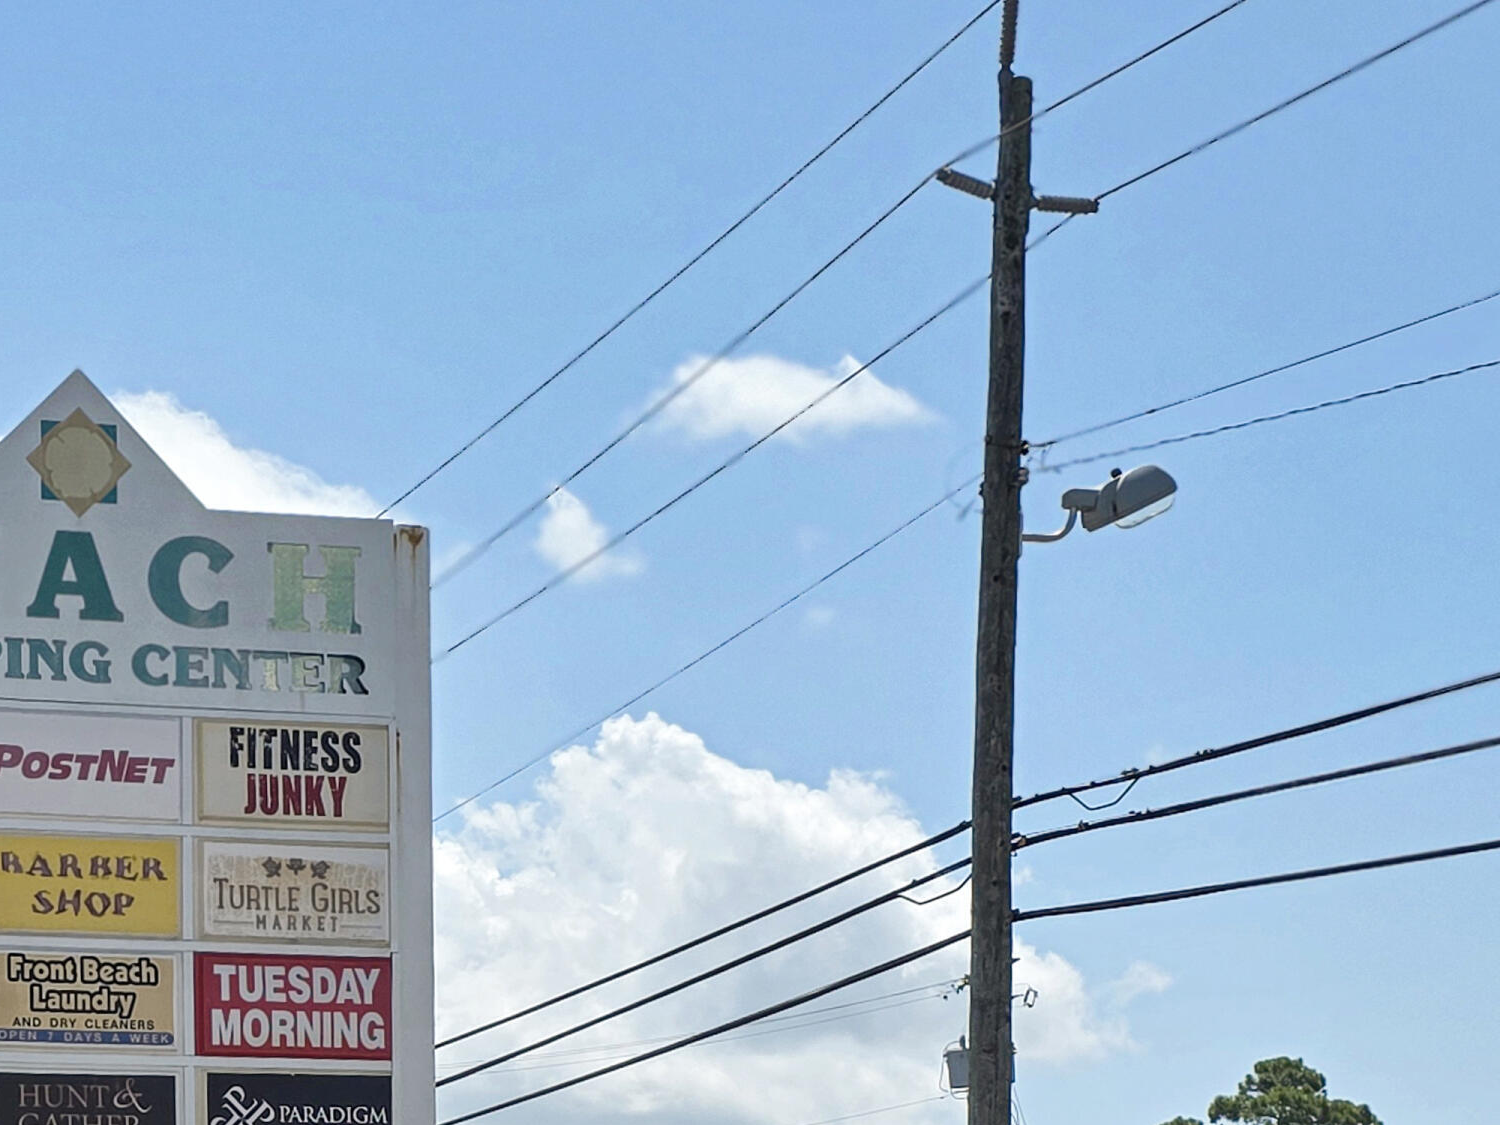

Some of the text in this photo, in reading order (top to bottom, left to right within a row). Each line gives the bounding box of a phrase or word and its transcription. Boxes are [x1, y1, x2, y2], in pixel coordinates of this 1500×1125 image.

[131, 643, 370, 697] CENTER
[229, 726, 362, 775] FITNESS
[243, 774, 348, 818] JUNKY
[0, 850, 168, 882] BARBER
[31, 888, 135, 918] SHOP
[255, 914, 340, 933] MARKET
[8, 953, 158, 985] Front Beach
[213, 964, 381, 1005] TUESDAY
[30, 984, 136, 1019] Laundry
[12, 1017, 155, 1031] AND DRY CLEANERS
[64, 1032, 101, 1042] DAYS
[111, 1033, 121, 1042] A
[129, 1033, 170, 1044] WEEK
[210, 1008, 387, 1050] MORNING
[18, 1078, 153, 1114] HUNT &
[279, 1105, 389, 1125] PARADIGM
